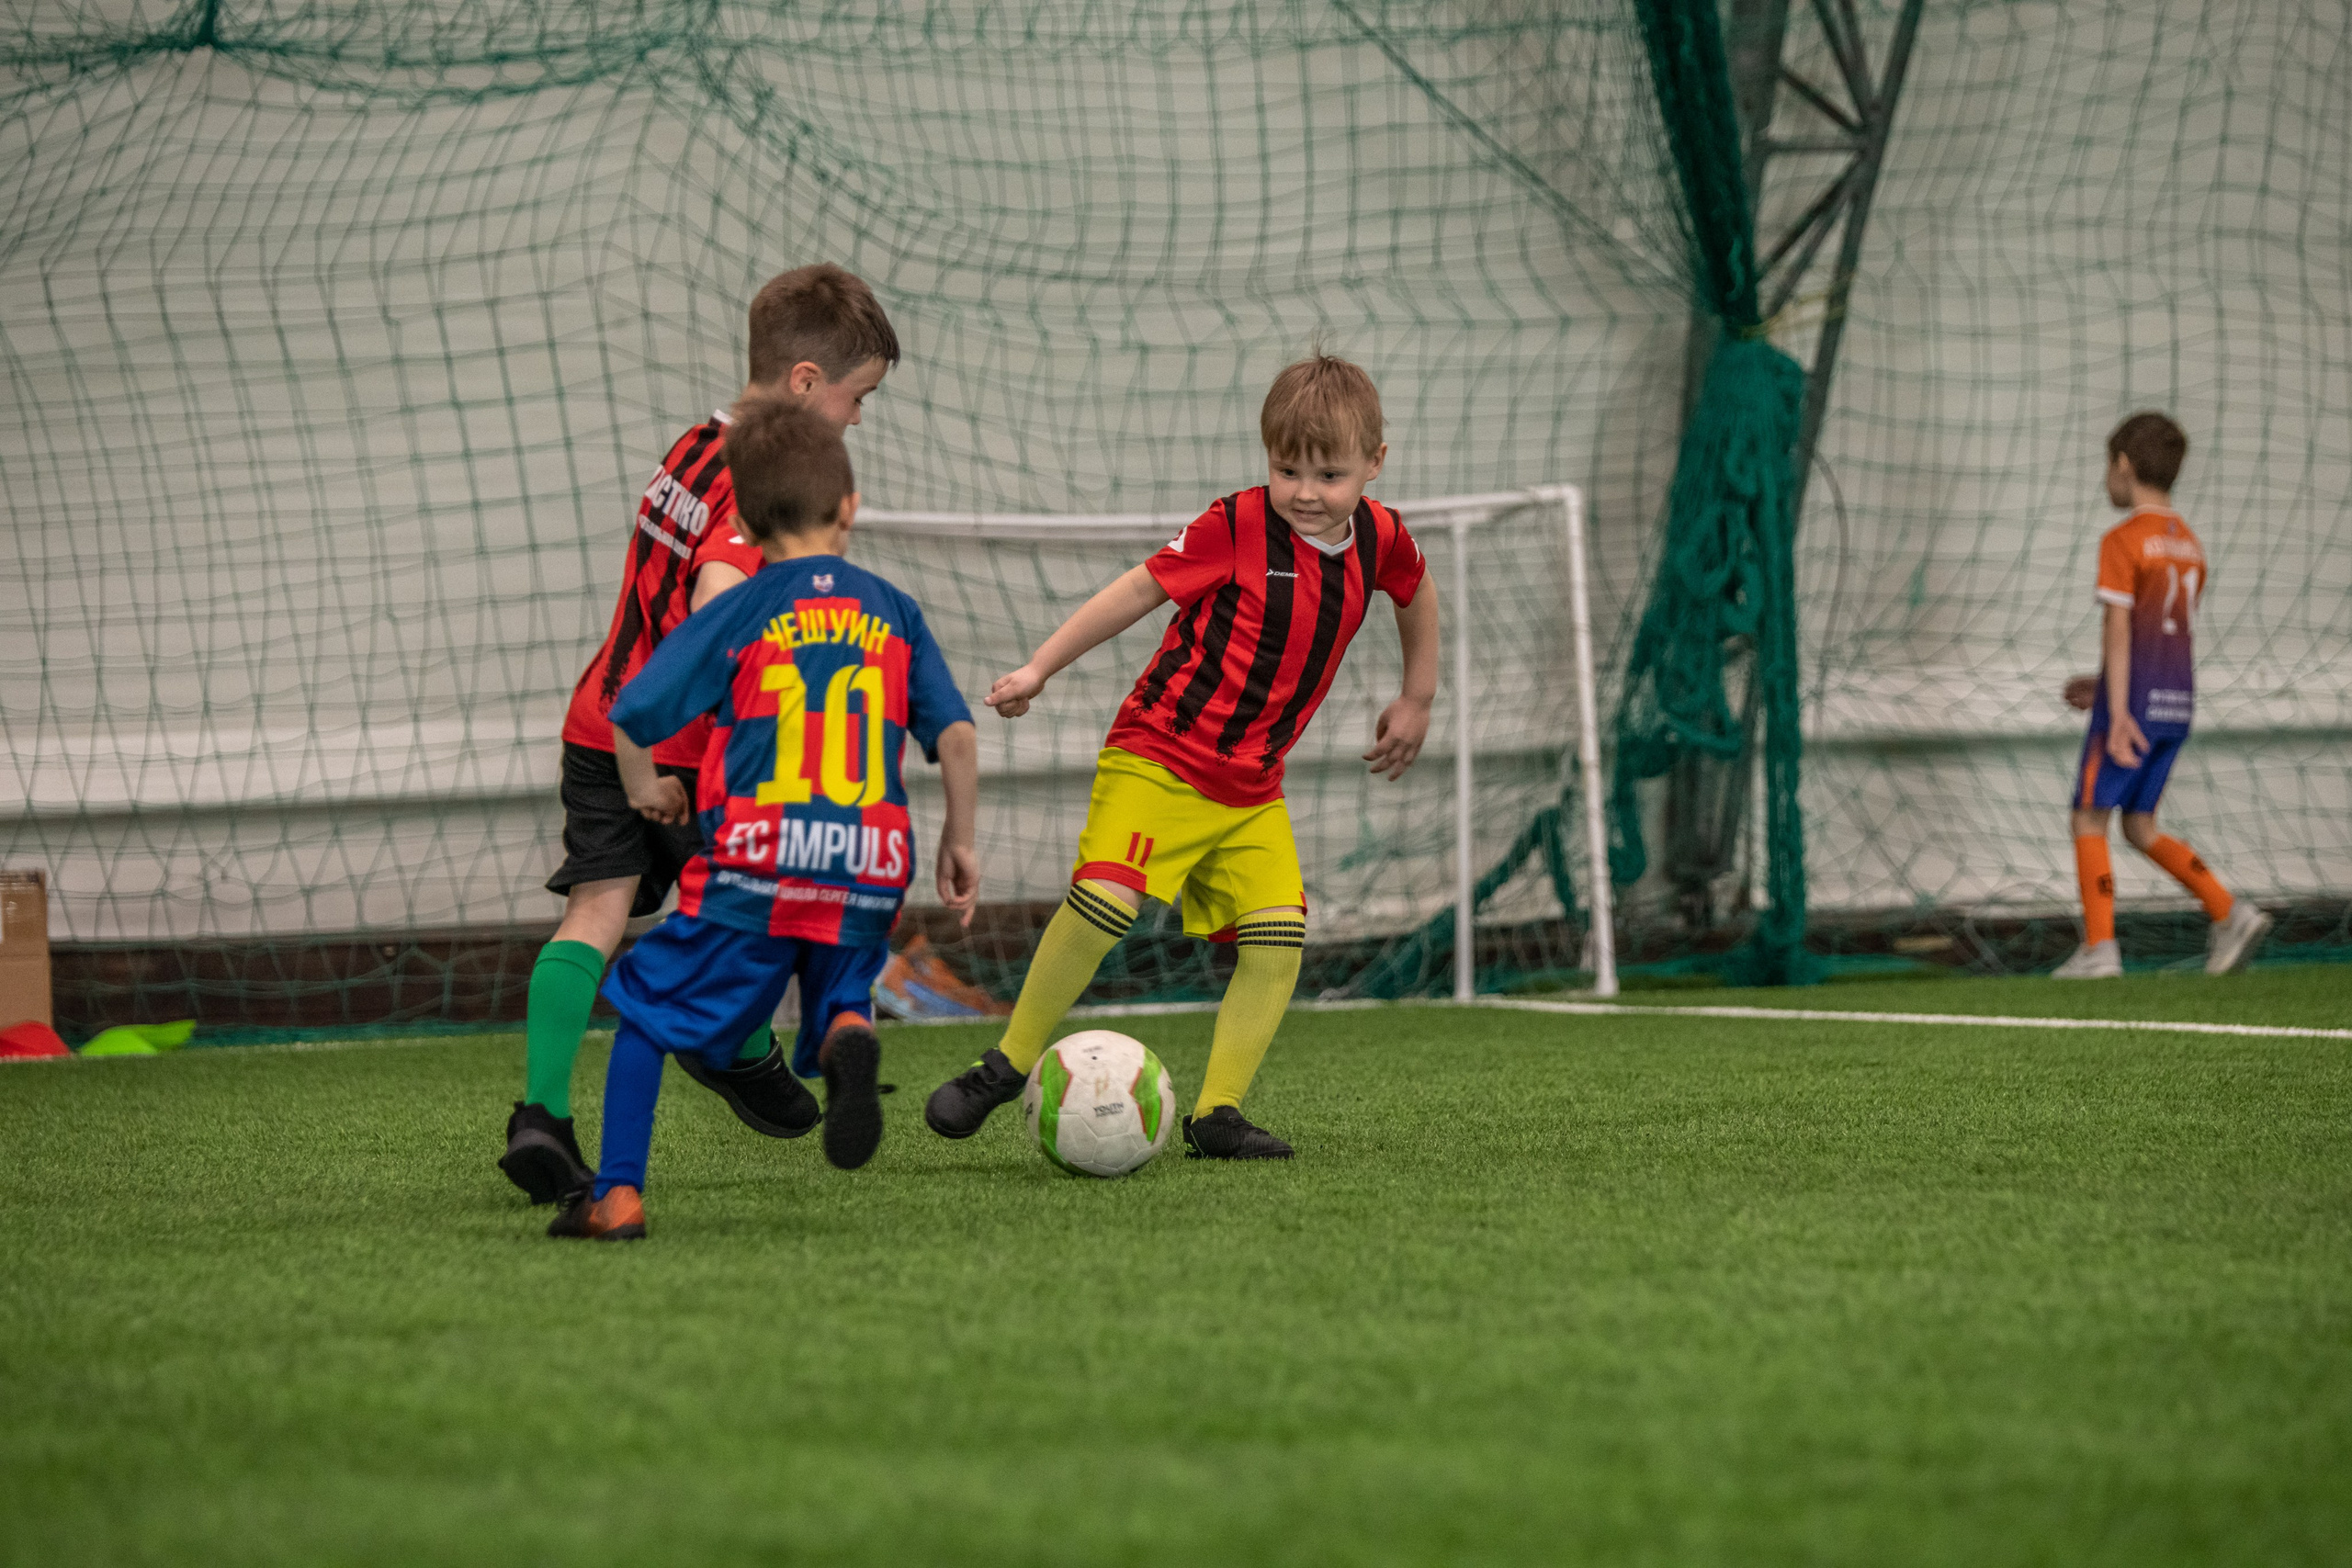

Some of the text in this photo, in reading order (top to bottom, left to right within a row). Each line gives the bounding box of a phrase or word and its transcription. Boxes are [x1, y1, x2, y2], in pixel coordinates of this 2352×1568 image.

[763, 608, 891, 654] ЧЕШУИН
[755, 663, 887, 807] 10
[725, 818, 903, 879] FC IMPULS
[1125, 831, 1155, 869] 11
